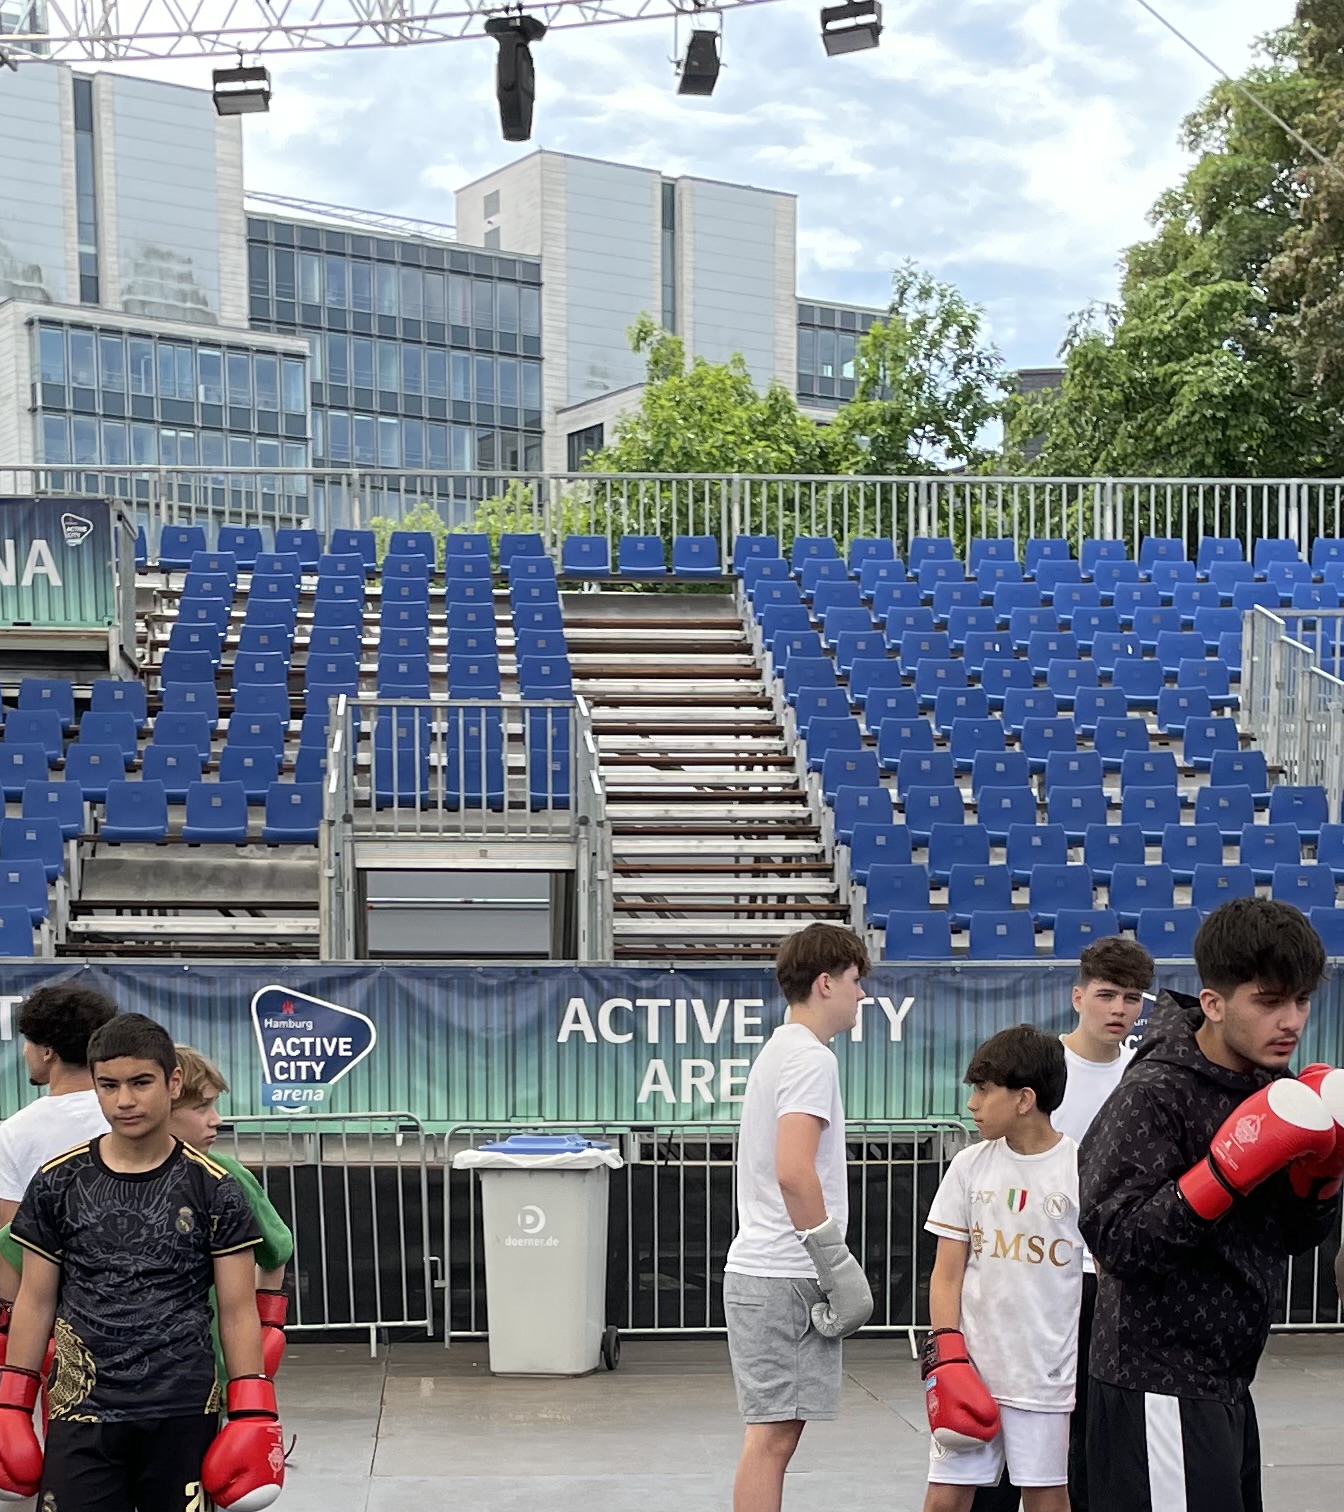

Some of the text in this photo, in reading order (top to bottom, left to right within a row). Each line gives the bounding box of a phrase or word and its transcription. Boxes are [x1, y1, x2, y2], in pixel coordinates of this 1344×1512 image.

[264, 1018, 313, 1031] Hamburg
[557, 997, 764, 1044] ACTIVE
[270, 1037, 353, 1057] ACTIVE
[273, 1061, 326, 1081] CITY
[637, 1058, 750, 1104] ARE
[271, 1088, 325, 1102] arena
[1049, 1198, 1064, 1214] N
[504, 1235, 560, 1247] doerner.de
[990, 1228, 1074, 1268] MSC
